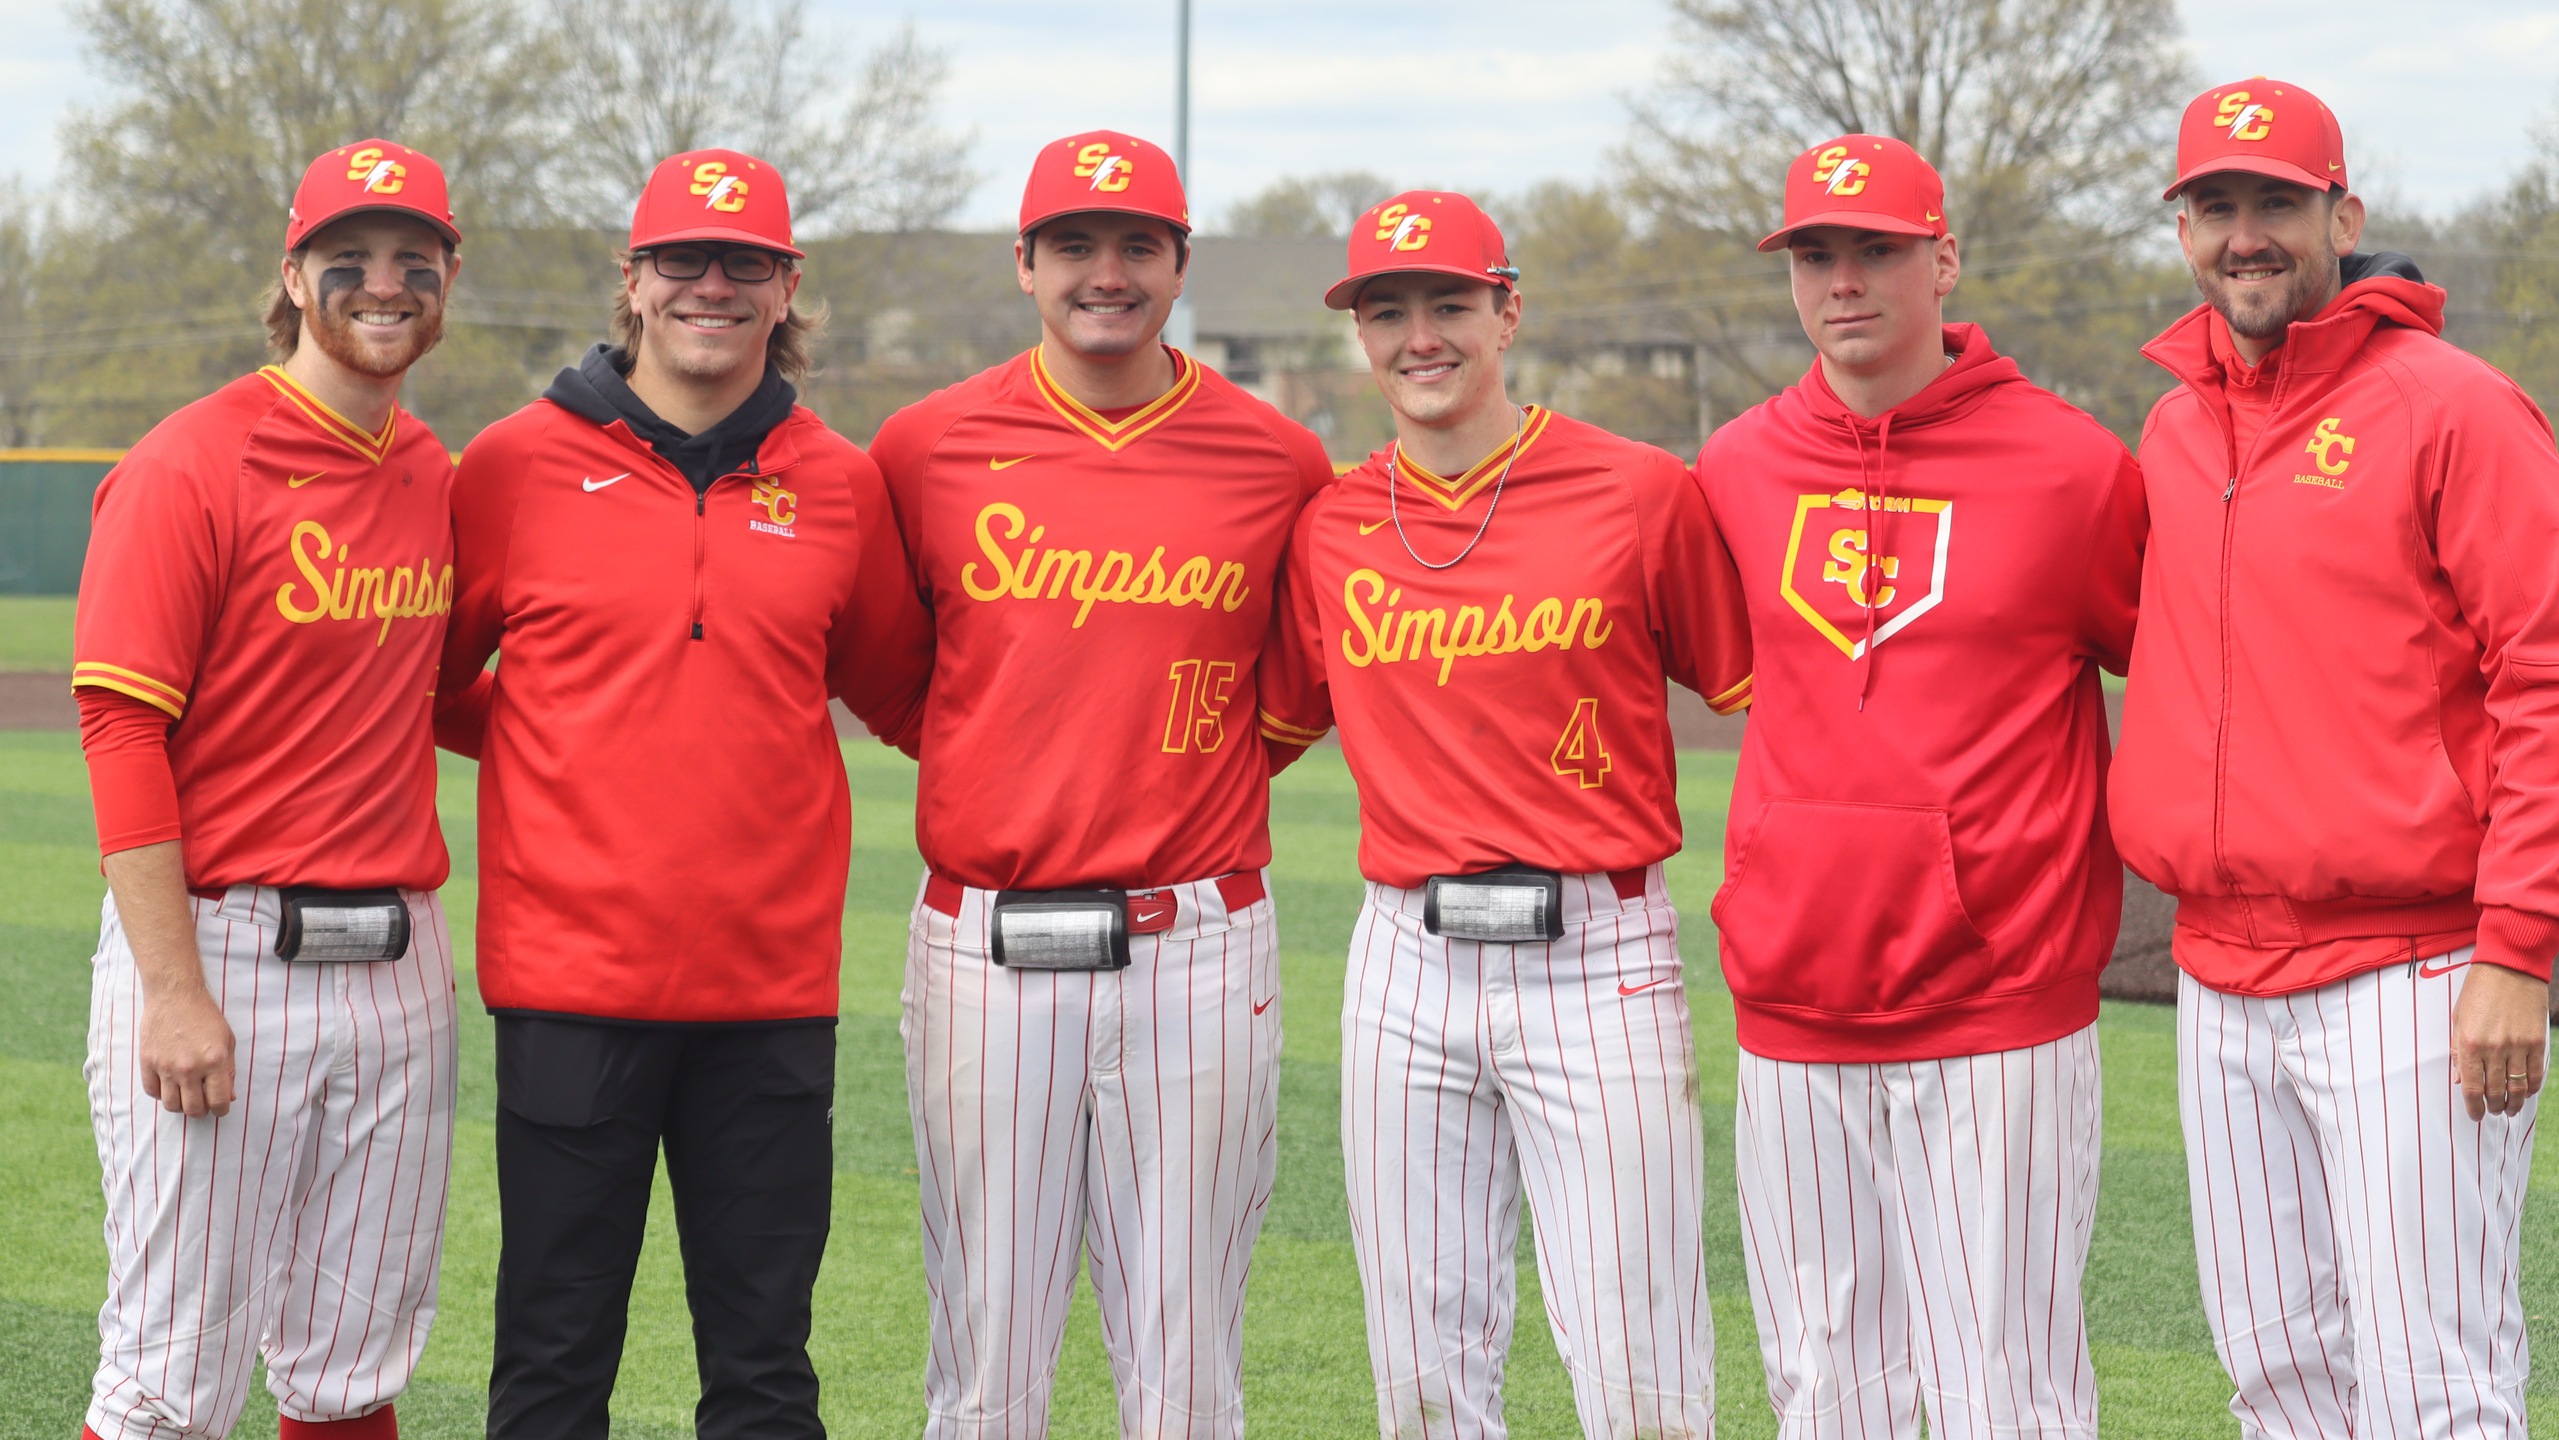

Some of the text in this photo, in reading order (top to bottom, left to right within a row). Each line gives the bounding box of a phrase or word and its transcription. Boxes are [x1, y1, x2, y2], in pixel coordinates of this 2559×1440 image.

[2214, 91, 2275, 141] SC
[347, 147, 407, 195] SC
[689, 161, 749, 214] SC
[1073, 142, 1133, 193] SC
[1812, 145, 1870, 196] SC
[1375, 203, 1433, 252] SC
[2304, 417, 2355, 476] SC
[751, 475, 797, 526] SC
[2293, 474, 2345, 490] BASEBALL
[749, 519, 796, 538] BASEBALL
[275, 520, 454, 648] Simpso
[960, 502, 1250, 630] Simpson
[1822, 528, 1900, 609] SC
[1341, 568, 1614, 687] Simpson
[1161, 658, 1236, 755] 15
[1549, 698, 1612, 790] 4
